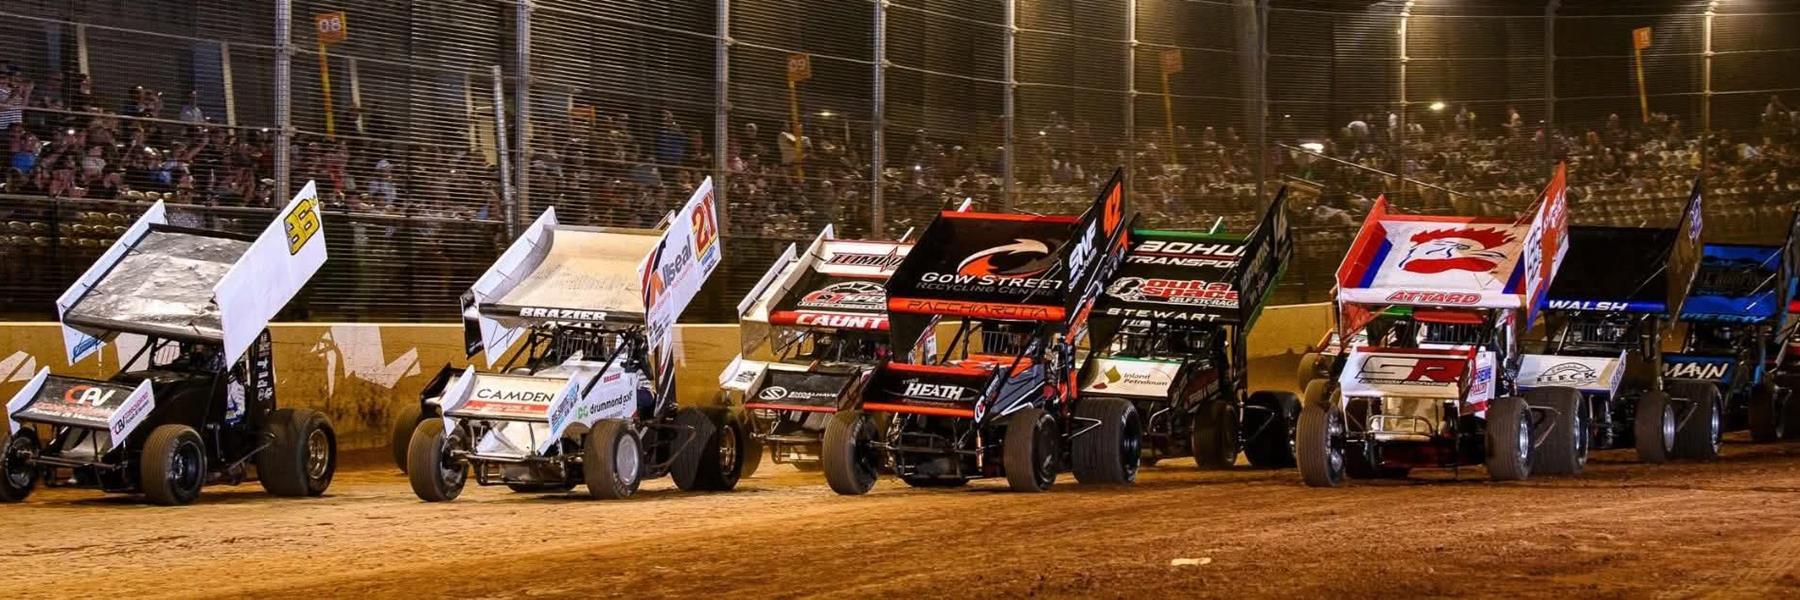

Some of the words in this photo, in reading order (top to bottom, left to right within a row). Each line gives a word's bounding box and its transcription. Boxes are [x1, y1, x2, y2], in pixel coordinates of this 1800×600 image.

[320, 18, 341, 32] 08
[1134, 240, 1246, 257] BOHU
[921, 272, 975, 284] GOW
[916, 282, 995, 293] RECYCLING
[998, 286, 1057, 296] CENTRE
[1169, 297, 1192, 305] SELF
[1386, 290, 1481, 304] ATTARD
[907, 301, 1050, 318] PACCHIAROTTA
[1549, 300, 1628, 311] WALSH
[520, 307, 607, 320] BRAZIER
[796, 313, 882, 328] CAUNT
[1106, 307, 1221, 322] STEWART
[477, 389, 554, 402] CAMDEN
[903, 382, 965, 400] HEATH
